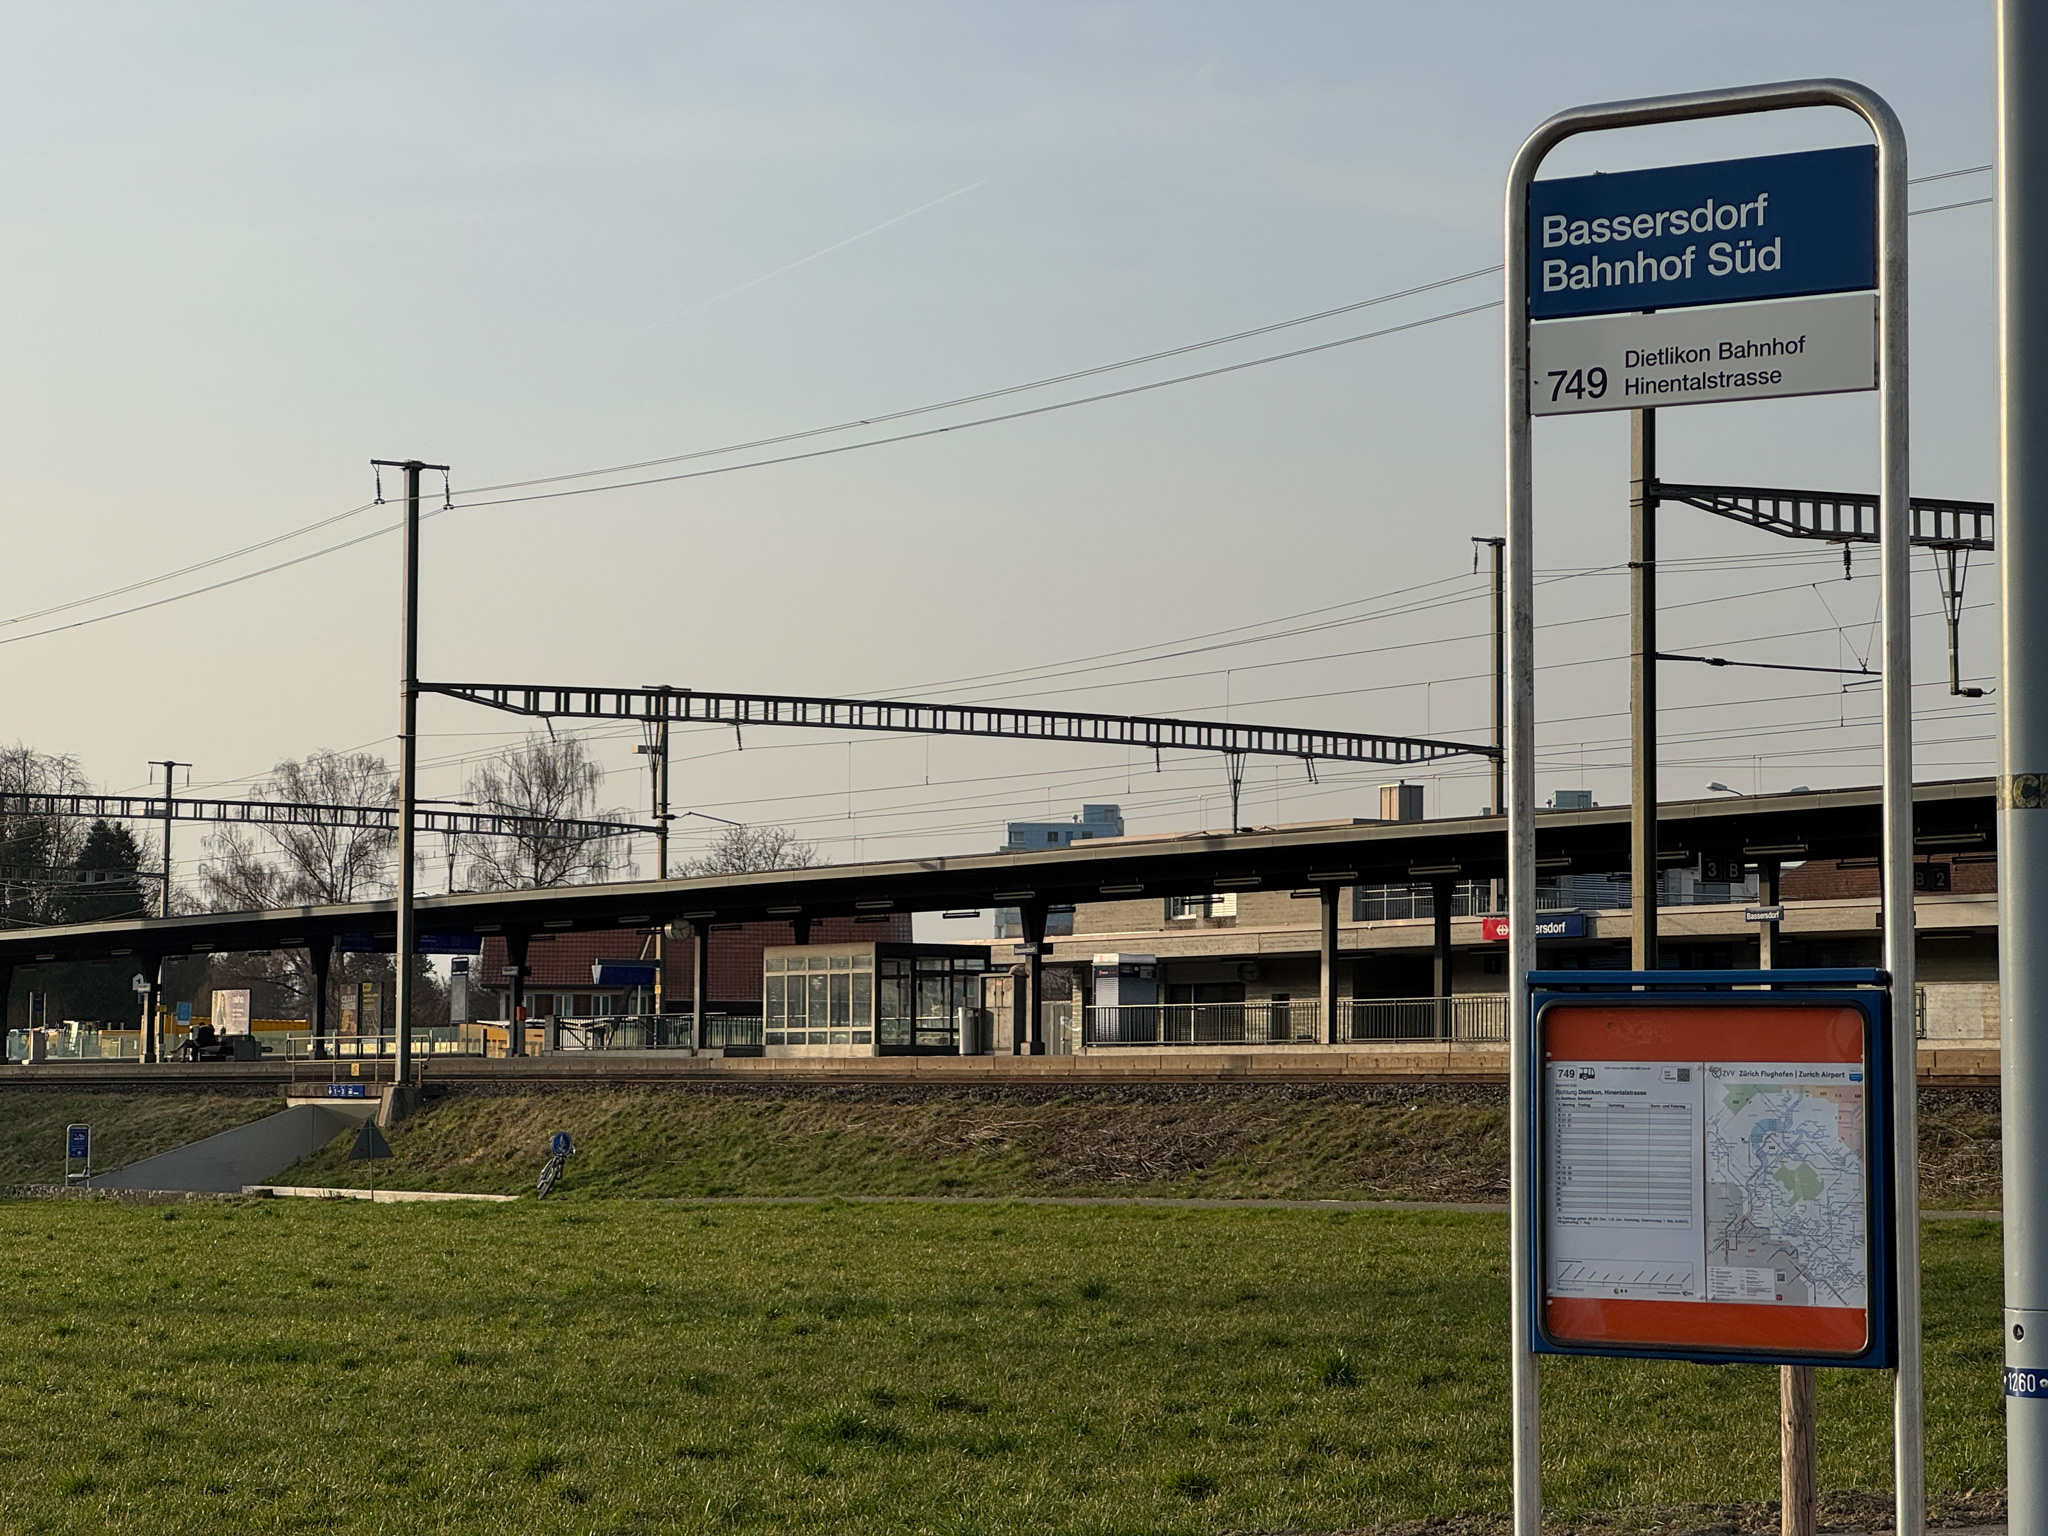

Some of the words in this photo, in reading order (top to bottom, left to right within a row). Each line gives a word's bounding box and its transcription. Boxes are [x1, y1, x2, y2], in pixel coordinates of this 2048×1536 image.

[1542, 193, 1769, 248] Bassersdorf
[1542, 245, 1696, 293] Bahnhof
[1707, 236, 1782, 277] Süd
[1625, 345, 1710, 369] Dietlikon
[1718, 335, 1806, 361] Bahnhof
[1548, 366, 1608, 402] 749
[1625, 367, 1782, 396] Hinentalstrasse
[1708, 862, 1717, 877] 3
[1729, 863, 1739, 878] B
[1936, 872, 1945, 886] 2
[1746, 910, 1780, 920] Bassersdorf
[1535, 921, 1566, 934] ersdorf
[1558, 1069, 1575, 1079] 749
[1739, 1069, 1759, 1078] Zürich
[1760, 1069, 1794, 1080] Flughafen
[1799, 1070, 1820, 1079] Zurich
[1821, 1071, 1845, 1080] Airport
[1555, 1089, 1577, 1097] Richtung
[2008, 1371, 2036, 1393] 1260
